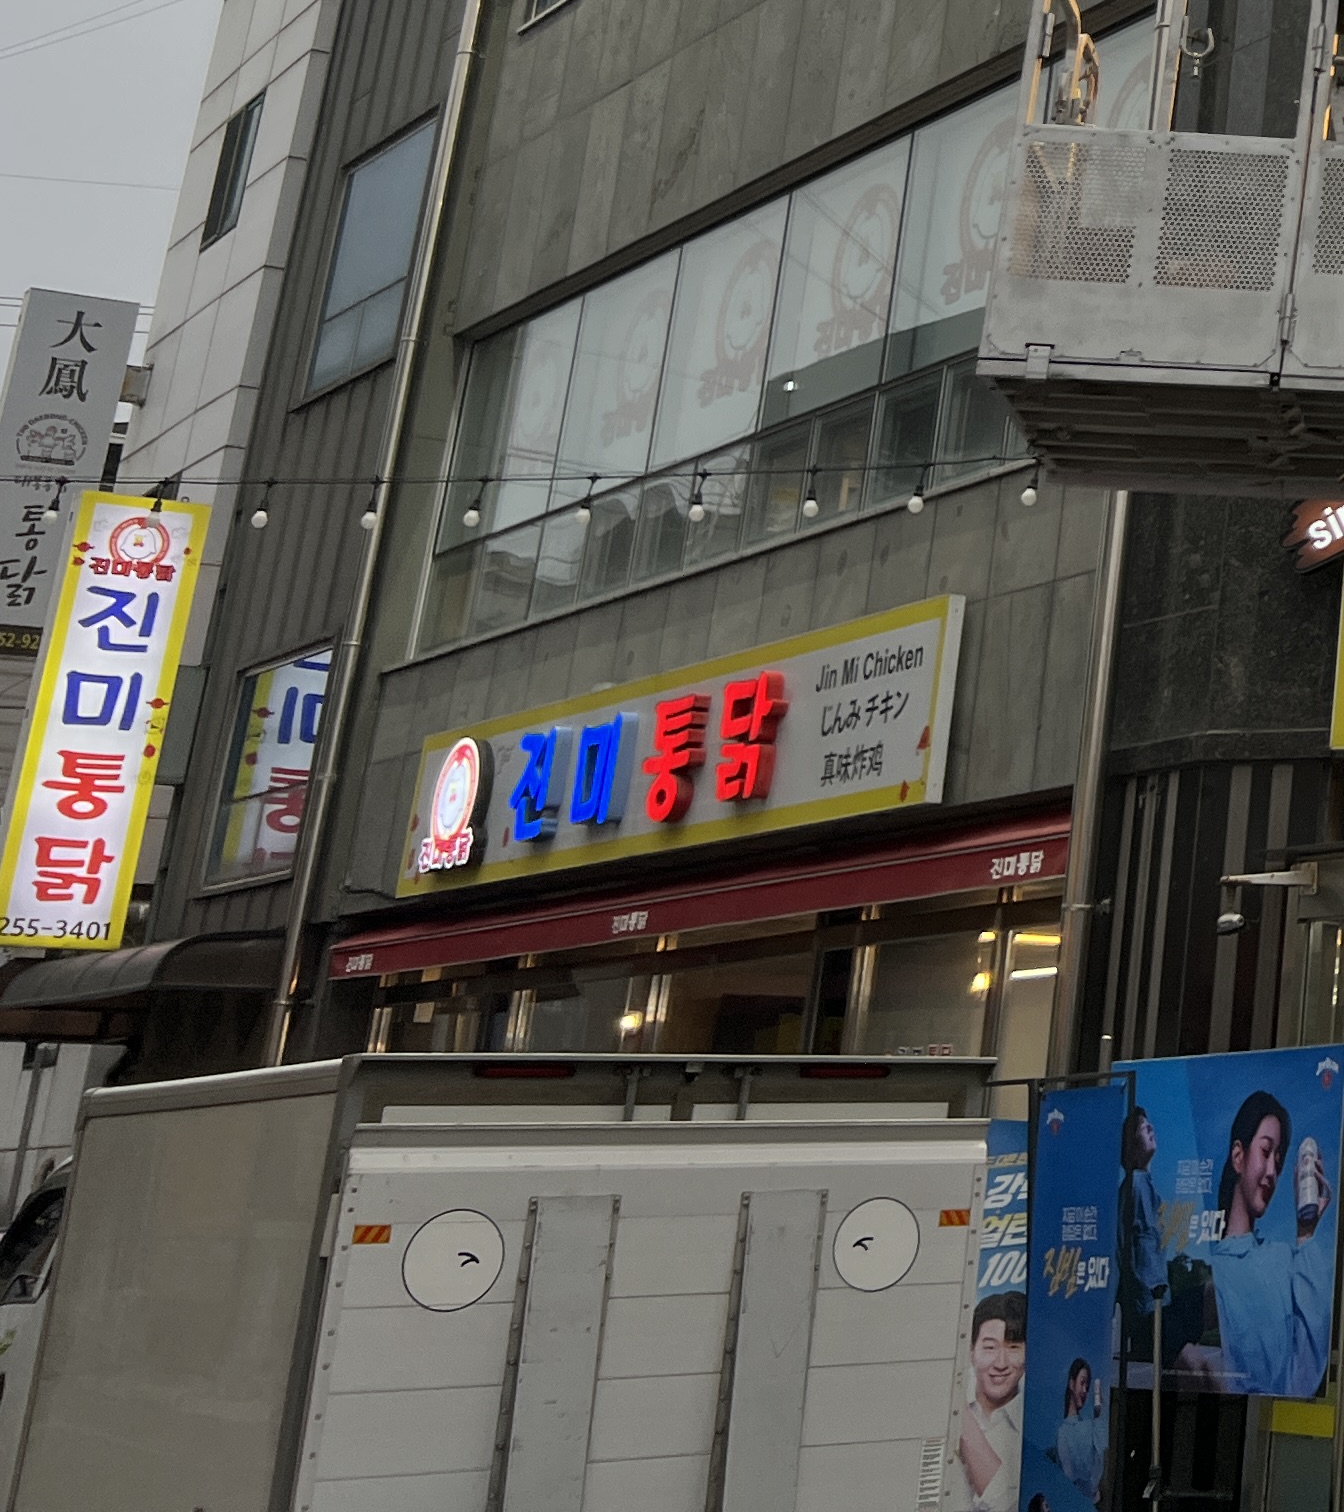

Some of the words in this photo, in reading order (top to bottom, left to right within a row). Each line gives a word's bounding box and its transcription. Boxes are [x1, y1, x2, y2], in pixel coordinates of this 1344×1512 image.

[816, 664, 838, 693] Jin
[841, 656, 860, 686] Mi
[863, 645, 925, 680] Chicken
[865, 690, 910, 728] チキン
[32, 586, 160, 905] 진미통닭
[509, 671, 787, 842] 진미통닭
[990, 850, 1045, 880] 진미통닭
[0, 916, 111, 941] 255-3401
[1084, 1256, 1110, 1292] 있다
